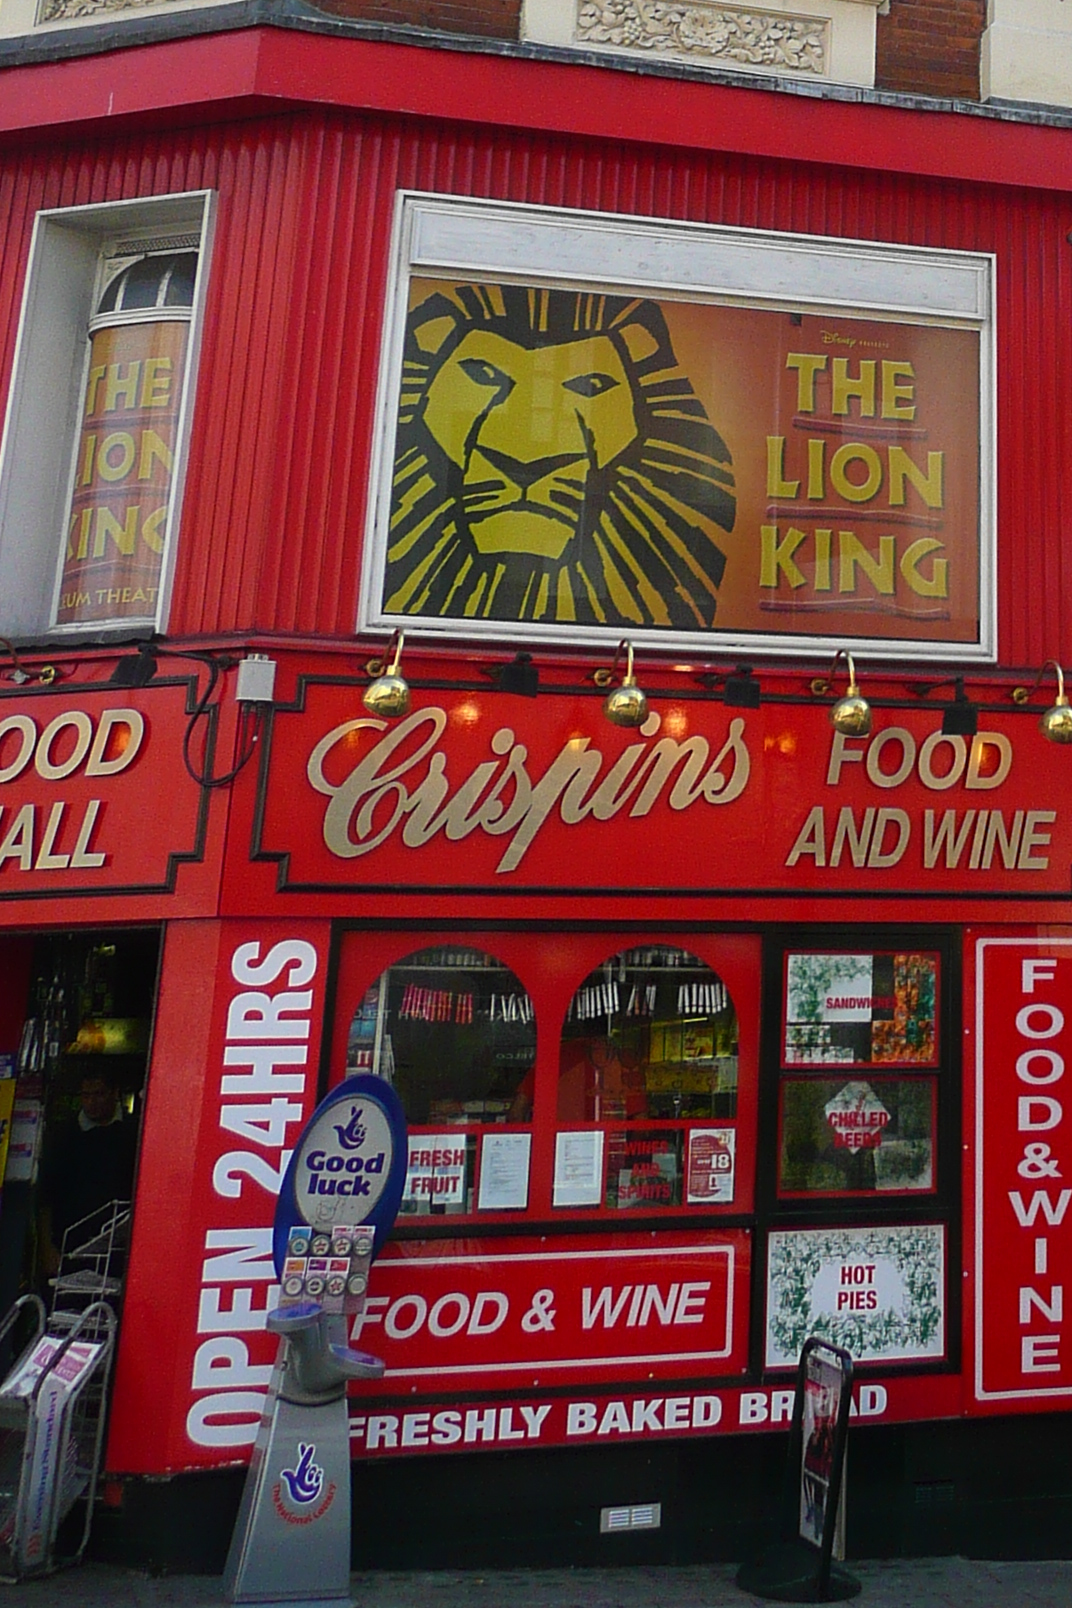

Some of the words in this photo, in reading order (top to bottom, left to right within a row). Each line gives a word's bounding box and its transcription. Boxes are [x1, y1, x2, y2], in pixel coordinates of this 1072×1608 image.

[785, 352, 917, 421] THE
[74, 429, 174, 490] ION
[766, 435, 944, 509] LION
[760, 525, 948, 598] KING
[827, 726, 1012, 790] FOOD
[307, 707, 751, 873] Crispins
[0, 800, 106, 871] ALL
[785, 806, 911, 868] AND
[924, 808, 1057, 870] WINE
[212, 939, 317, 1198] 24HRS
[828, 1111, 888, 1128] CHILLED
[306, 1150, 385, 1174] Good
[307, 1173, 371, 1196] luck
[410, 1148, 464, 1167] FRESH
[411, 1176, 460, 1195] FRUIT
[711, 1154, 730, 1169] 18
[1017, 1143, 1063, 1179] &
[837, 1290, 878, 1311] PIES
[840, 1265, 875, 1285] HOT
[186, 1228, 280, 1447] OPEN
[350, 1292, 509, 1341] FOOD
[521, 1289, 556, 1332] &
[581, 1282, 711, 1329] WINE
[348, 1405, 552, 1449] FRESHLY
[567, 1395, 722, 1436] BAKED
[739, 1384, 887, 1426] BRD
